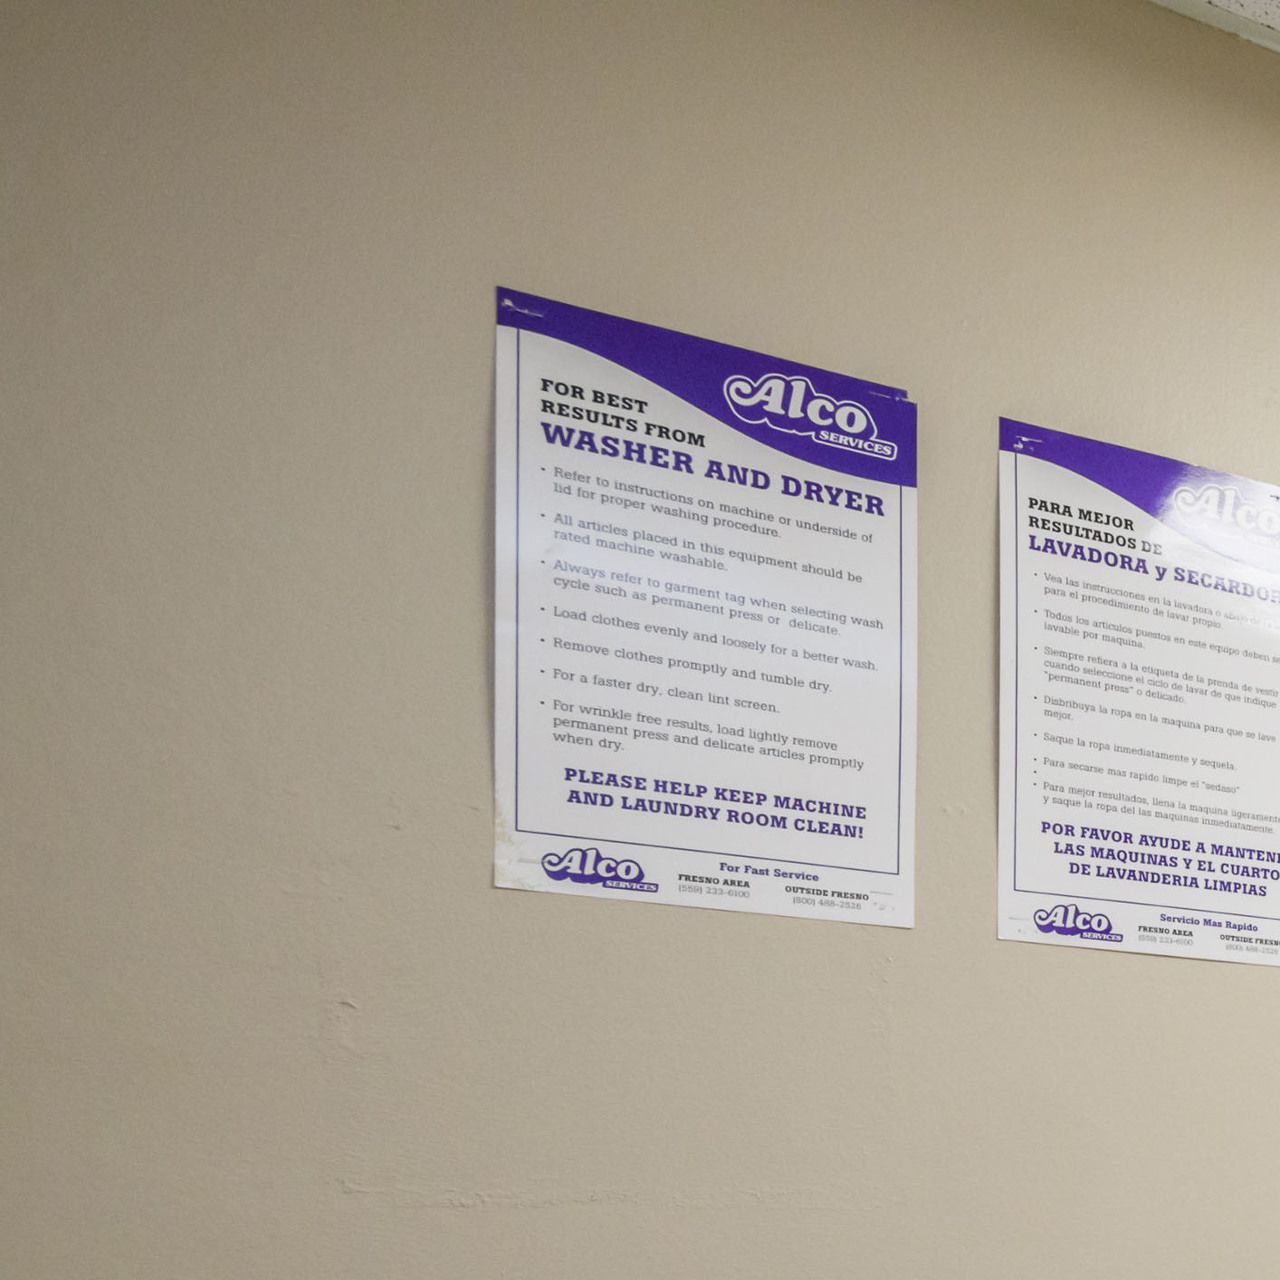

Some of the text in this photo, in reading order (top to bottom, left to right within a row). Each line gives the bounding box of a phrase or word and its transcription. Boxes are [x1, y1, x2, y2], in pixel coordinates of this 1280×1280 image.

[540, 377, 649, 414] FOR BEST
[729, 378, 868, 434] Alco
[540, 398, 706, 449] RESULTS FROM
[819, 430, 892, 456] SERVICES
[540, 421, 885, 517] WASHER AND DRYER
[553, 465, 873, 544] Refer to instructions on machine or underside of
[553, 481, 782, 538] lid for proper washing procedure.
[1028, 496, 1135, 532] PARA MEJOR
[552, 512, 863, 584] All articles placed in this equipment should be
[553, 529, 729, 572] rated machine washable.
[1028, 514, 1163, 556] RESULTADOS DE
[1028, 533, 1150, 575] LAVADORA
[1154, 564, 1168, 582] y
[552, 559, 884, 630] Always refer to garment tag when selecting wash
[552, 576, 841, 637] cycle such as permanent press or delicate.
[553, 605, 879, 672] Load clothes evenly and loosely for a better wash.
[553, 636, 833, 695] Remove clothes promptly and tumble dry.
[551, 667, 781, 714] For a faster dry, clean lint screen.
[552, 698, 838, 752] For wrinkle free results, load lightly remove
[552, 731, 625, 753] when dry.
[552, 717, 865, 772] permanent press and delicate articles promptly
[564, 767, 867, 820] PLEASE HELP KEEP MACHINE
[566, 789, 864, 840] AND LAUNDRY ROOM CLEAN!
[1040, 820, 1076, 838] POR
[1080, 826, 1134, 845] FAVOR
[1138, 833, 1192, 853] AYUDE
[1194, 841, 1207, 855] A
[1053, 841, 1280, 881] LAS MAQUINAS Y EL CUARTO
[542, 848, 642, 881] Alco
[605, 880, 657, 892] SERVICES
[677, 873, 751, 889] FRESNO AREA
[719, 861, 820, 882] For Fast Service
[1068, 861, 1268, 897] DE LAVANDERIA LIMPIAS
[784, 885, 870, 902] OUTSIDE FRESNO
[1034, 904, 1111, 933] Alco
